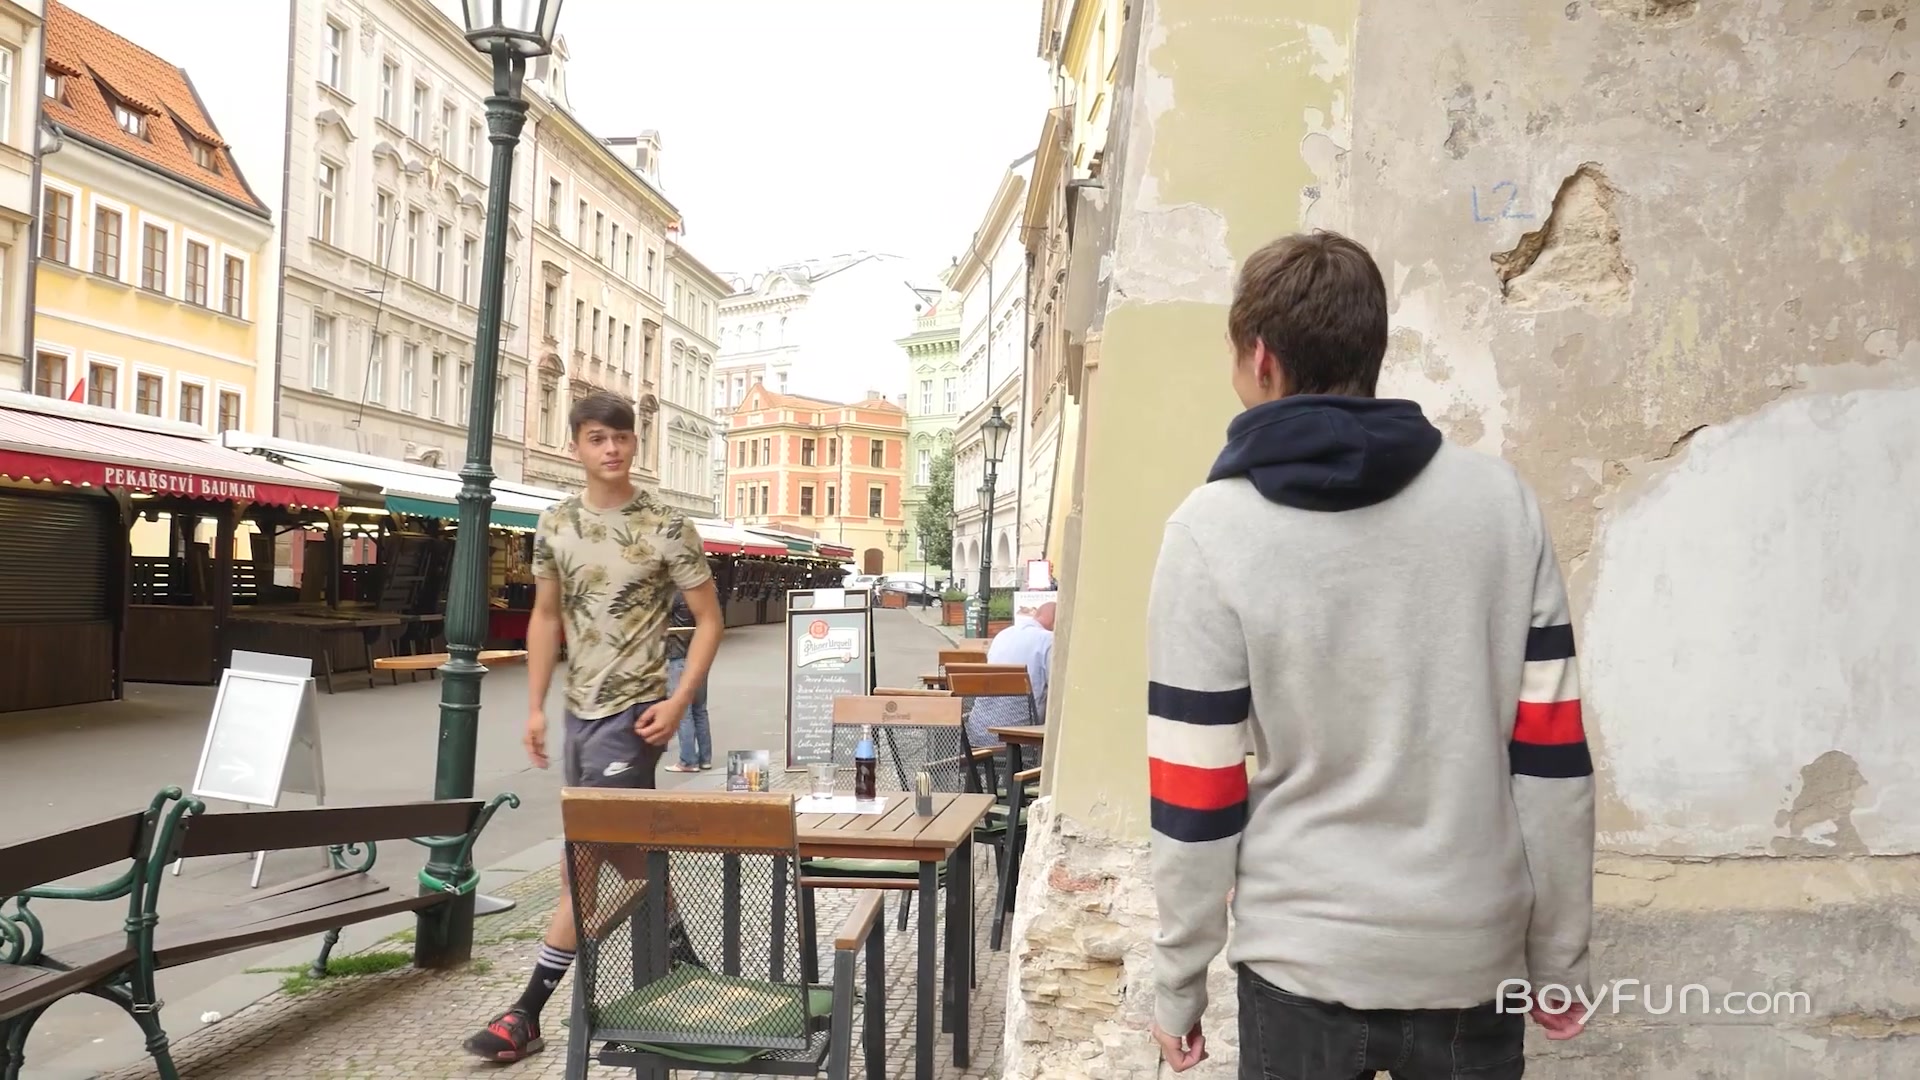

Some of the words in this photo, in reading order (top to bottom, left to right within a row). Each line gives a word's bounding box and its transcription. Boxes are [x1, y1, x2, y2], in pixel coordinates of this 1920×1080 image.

[1472, 181, 1534, 222] L2
[104, 467, 194, 494] PEKAŘSTVÍ
[201, 478, 256, 499] BAUMAN
[803, 639, 828, 657] Pilsner
[828, 637, 853, 650] Urquell
